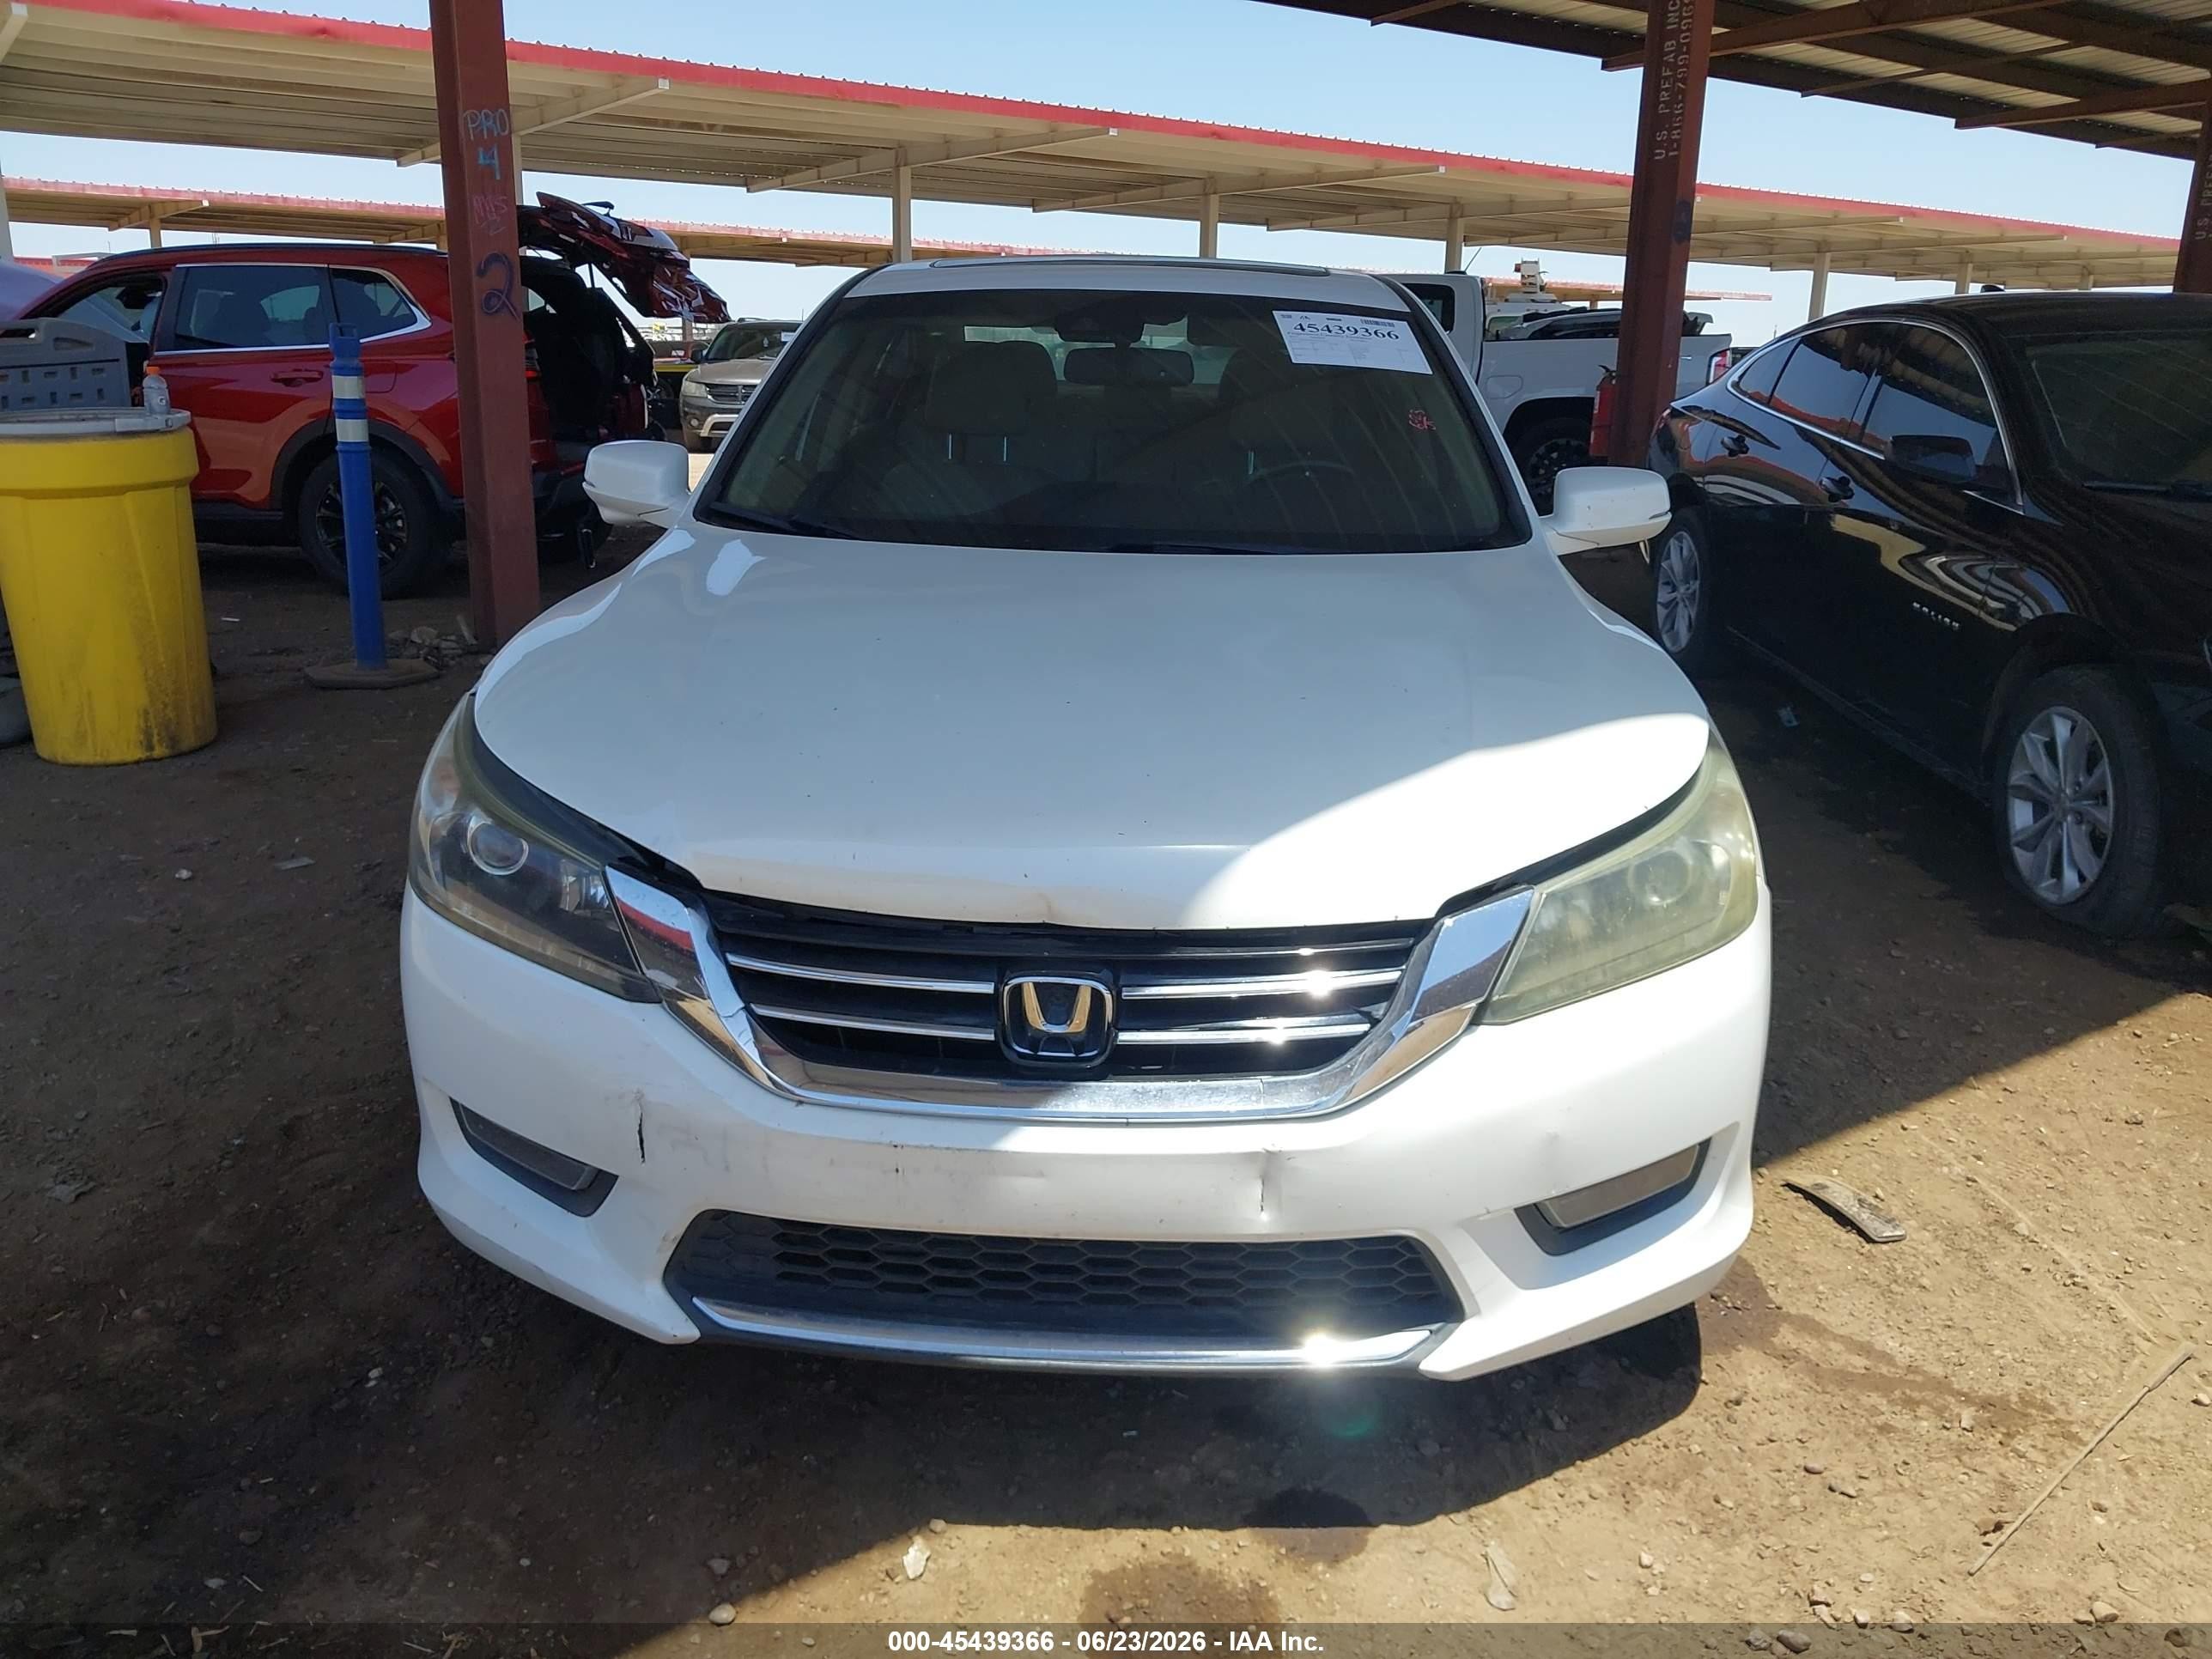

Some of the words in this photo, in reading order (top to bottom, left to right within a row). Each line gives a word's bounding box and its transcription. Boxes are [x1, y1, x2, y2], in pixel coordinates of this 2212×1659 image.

[1658, 40, 1677, 113] PREFAB
[463, 108, 510, 141] PRO
[1654, 125, 1669, 161] U.S.
[477, 142, 501, 180] 4
[475, 250, 520, 320] 2
[1293, 322, 1400, 340] 45439366
